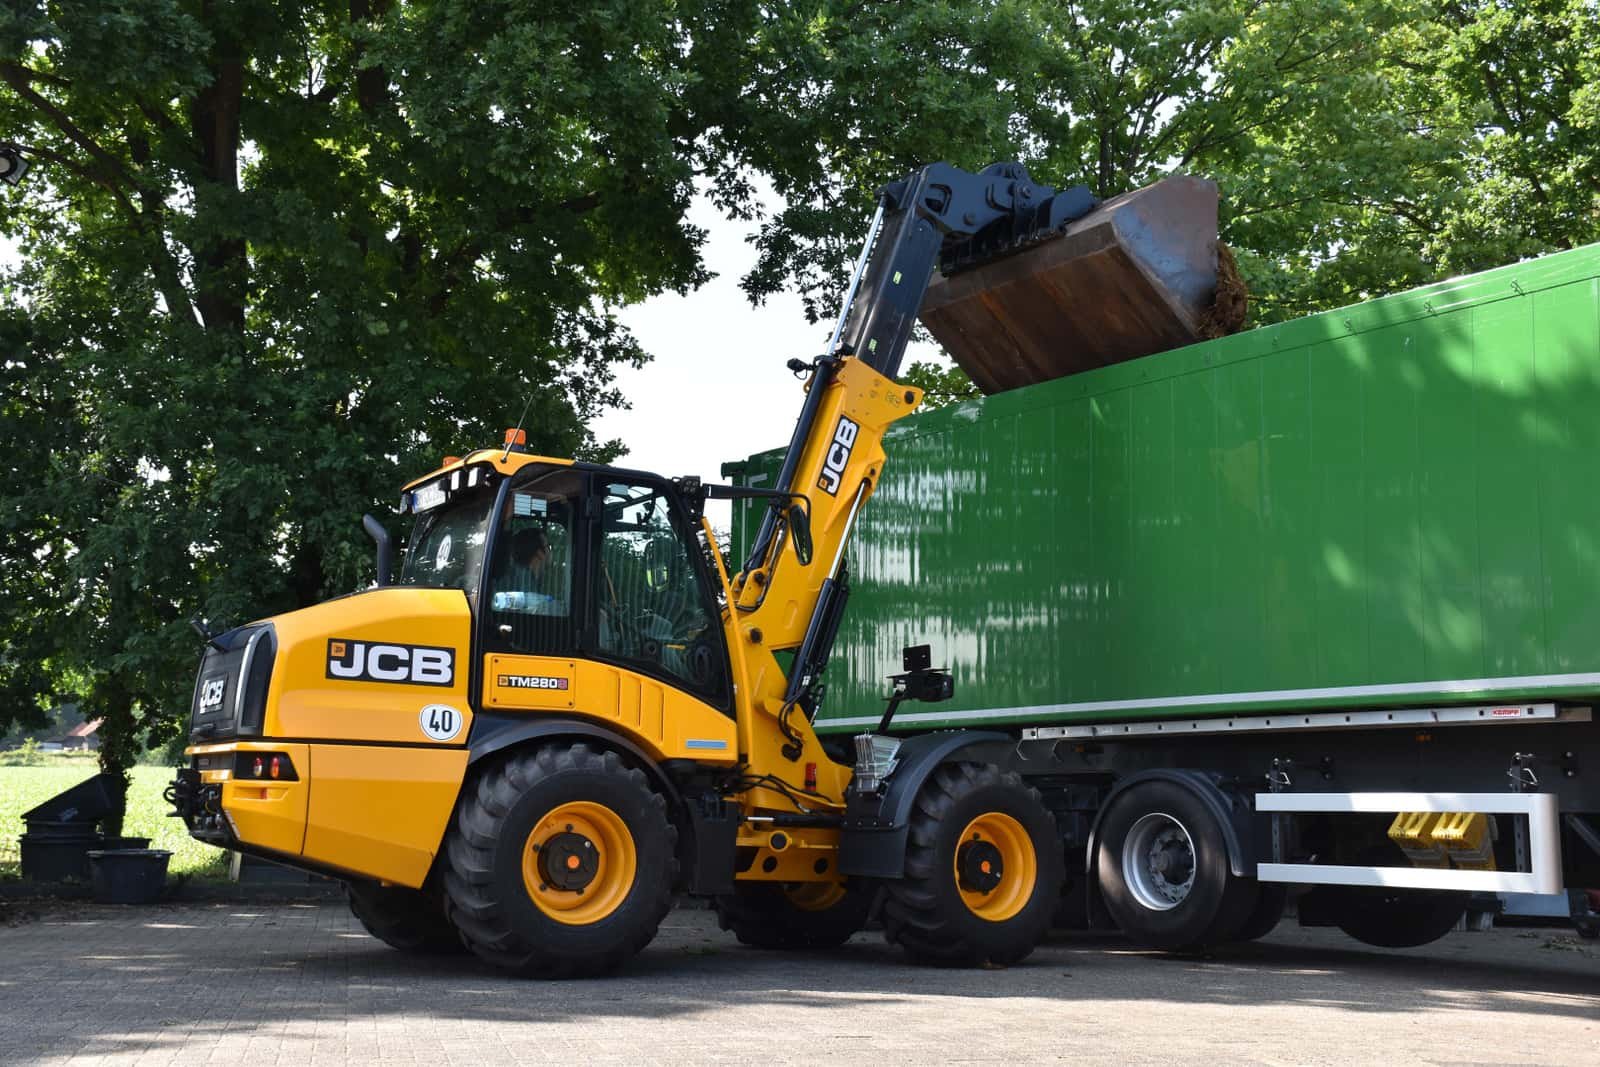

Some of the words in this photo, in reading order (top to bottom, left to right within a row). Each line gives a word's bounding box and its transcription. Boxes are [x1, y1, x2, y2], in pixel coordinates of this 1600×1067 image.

[822, 418, 857, 494] JCB
[330, 643, 452, 684] JCB
[200, 680, 224, 707] JCB
[429, 709, 453, 732] 40
